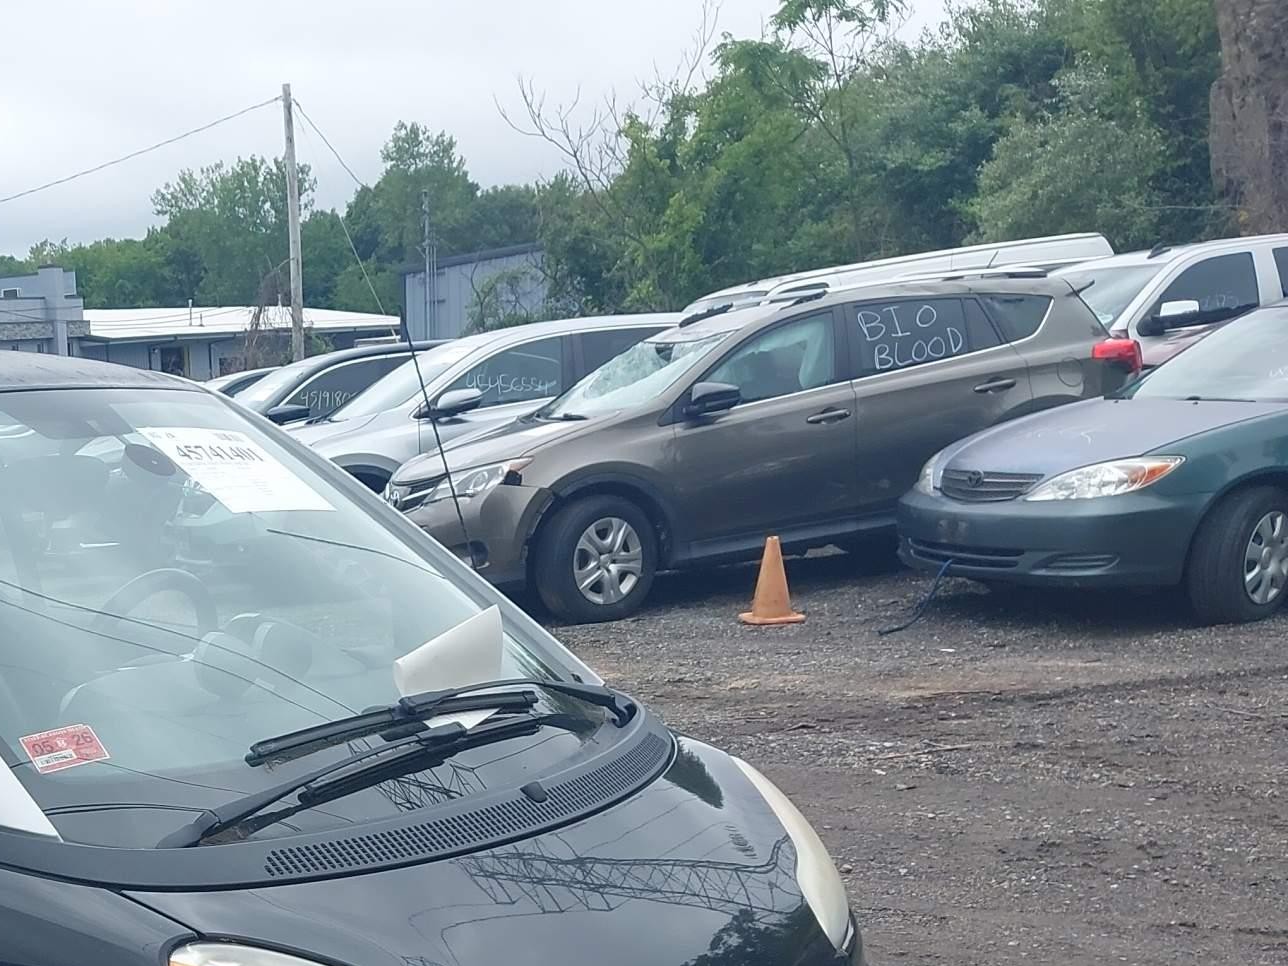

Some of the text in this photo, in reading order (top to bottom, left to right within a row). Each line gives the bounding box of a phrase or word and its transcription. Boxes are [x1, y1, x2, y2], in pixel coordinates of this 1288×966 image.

[857, 304, 937, 341] BIO
[874, 327, 963, 370] BLOOD
[175, 444, 265, 462] 45741401
[31, 740, 54, 755] 05
[72, 731, 93, 746] 26
